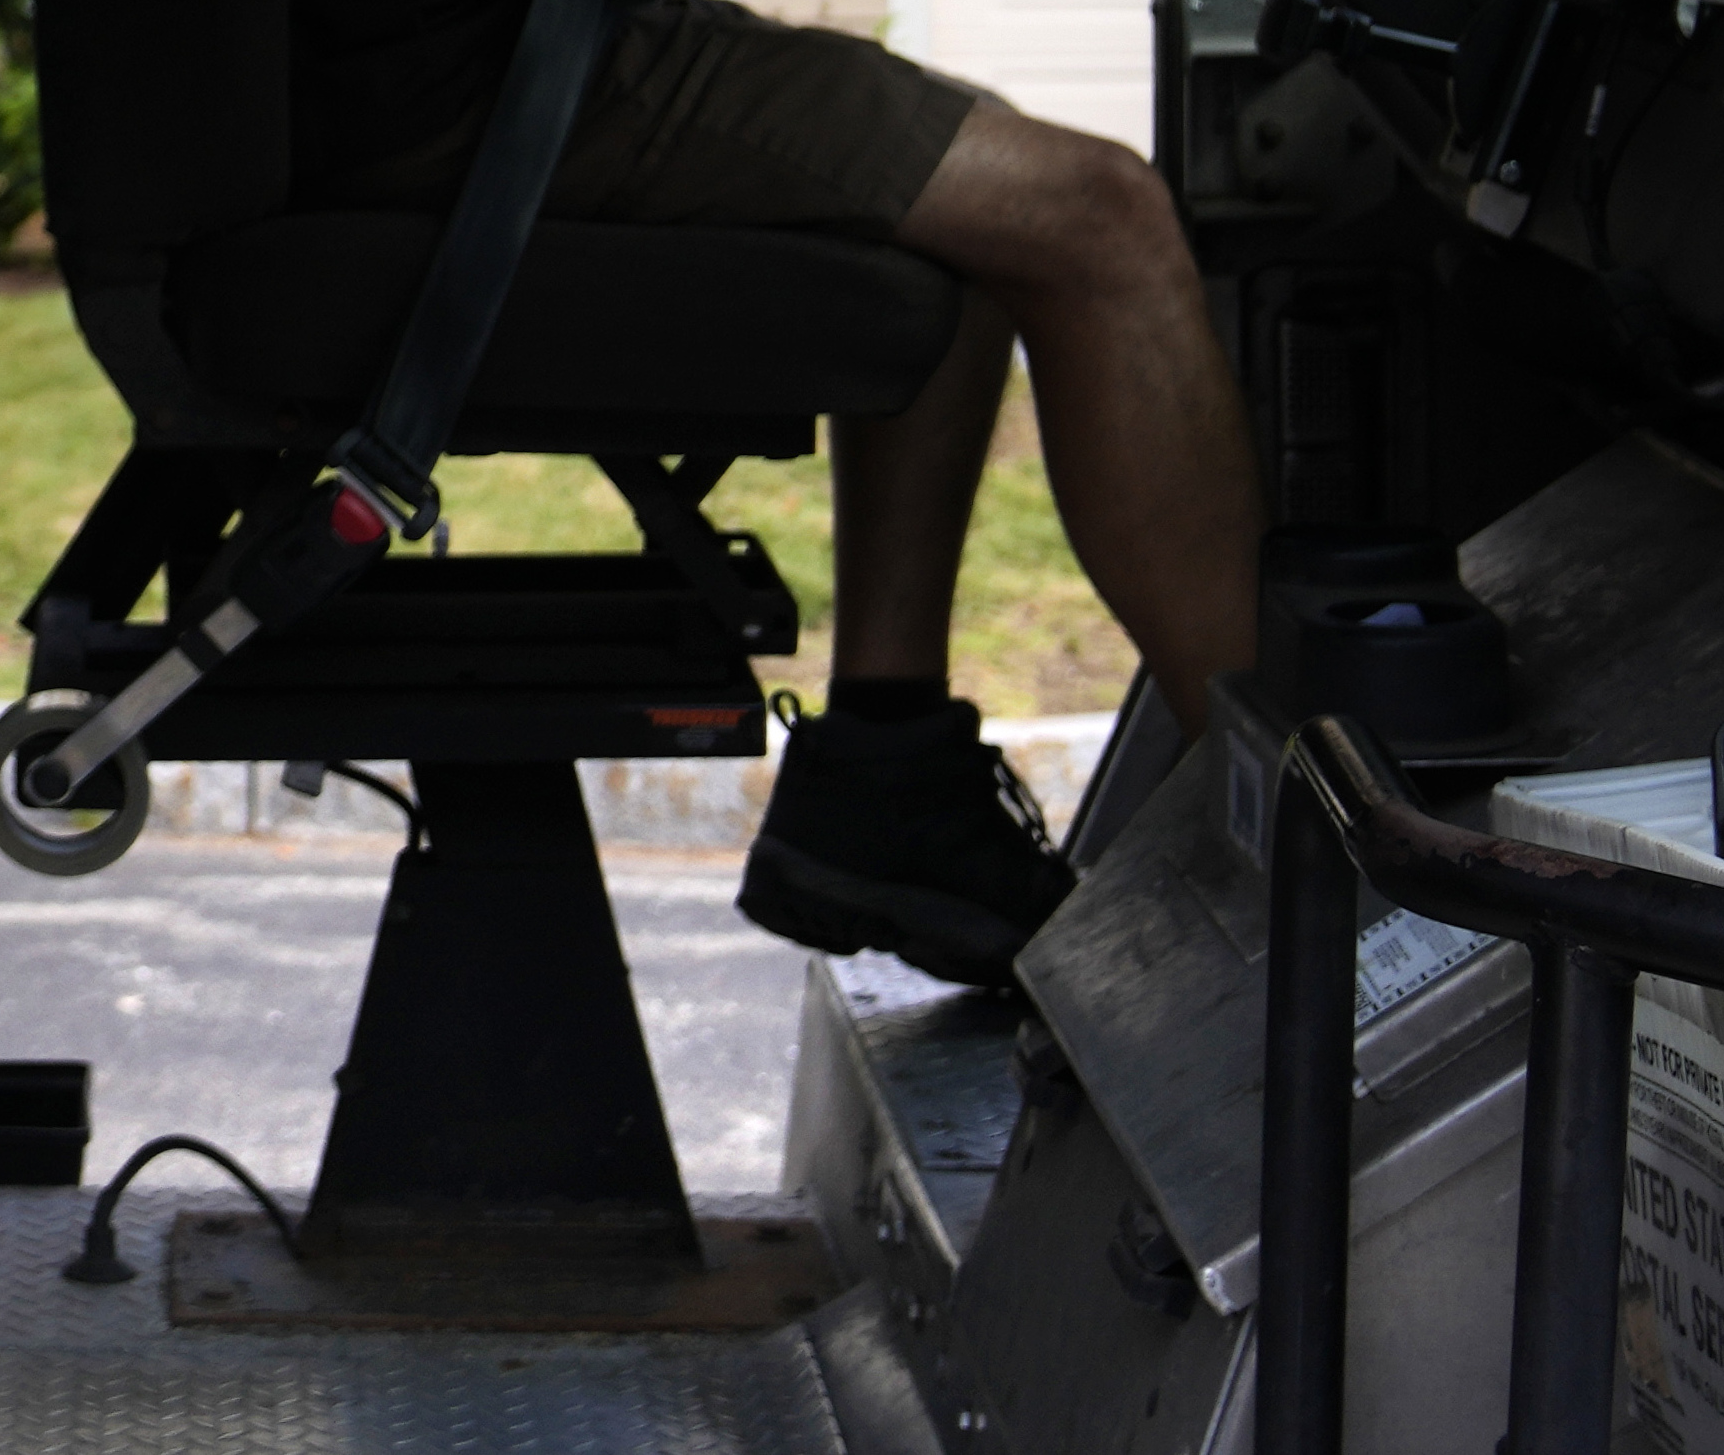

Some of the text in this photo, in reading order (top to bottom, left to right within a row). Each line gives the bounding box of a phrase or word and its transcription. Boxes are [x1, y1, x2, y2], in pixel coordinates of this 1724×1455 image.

[1661, 1044, 1685, 1084] FOR
[1683, 1188, 1724, 1278] STA
[1620, 1235, 1687, 1337] OSTAL
